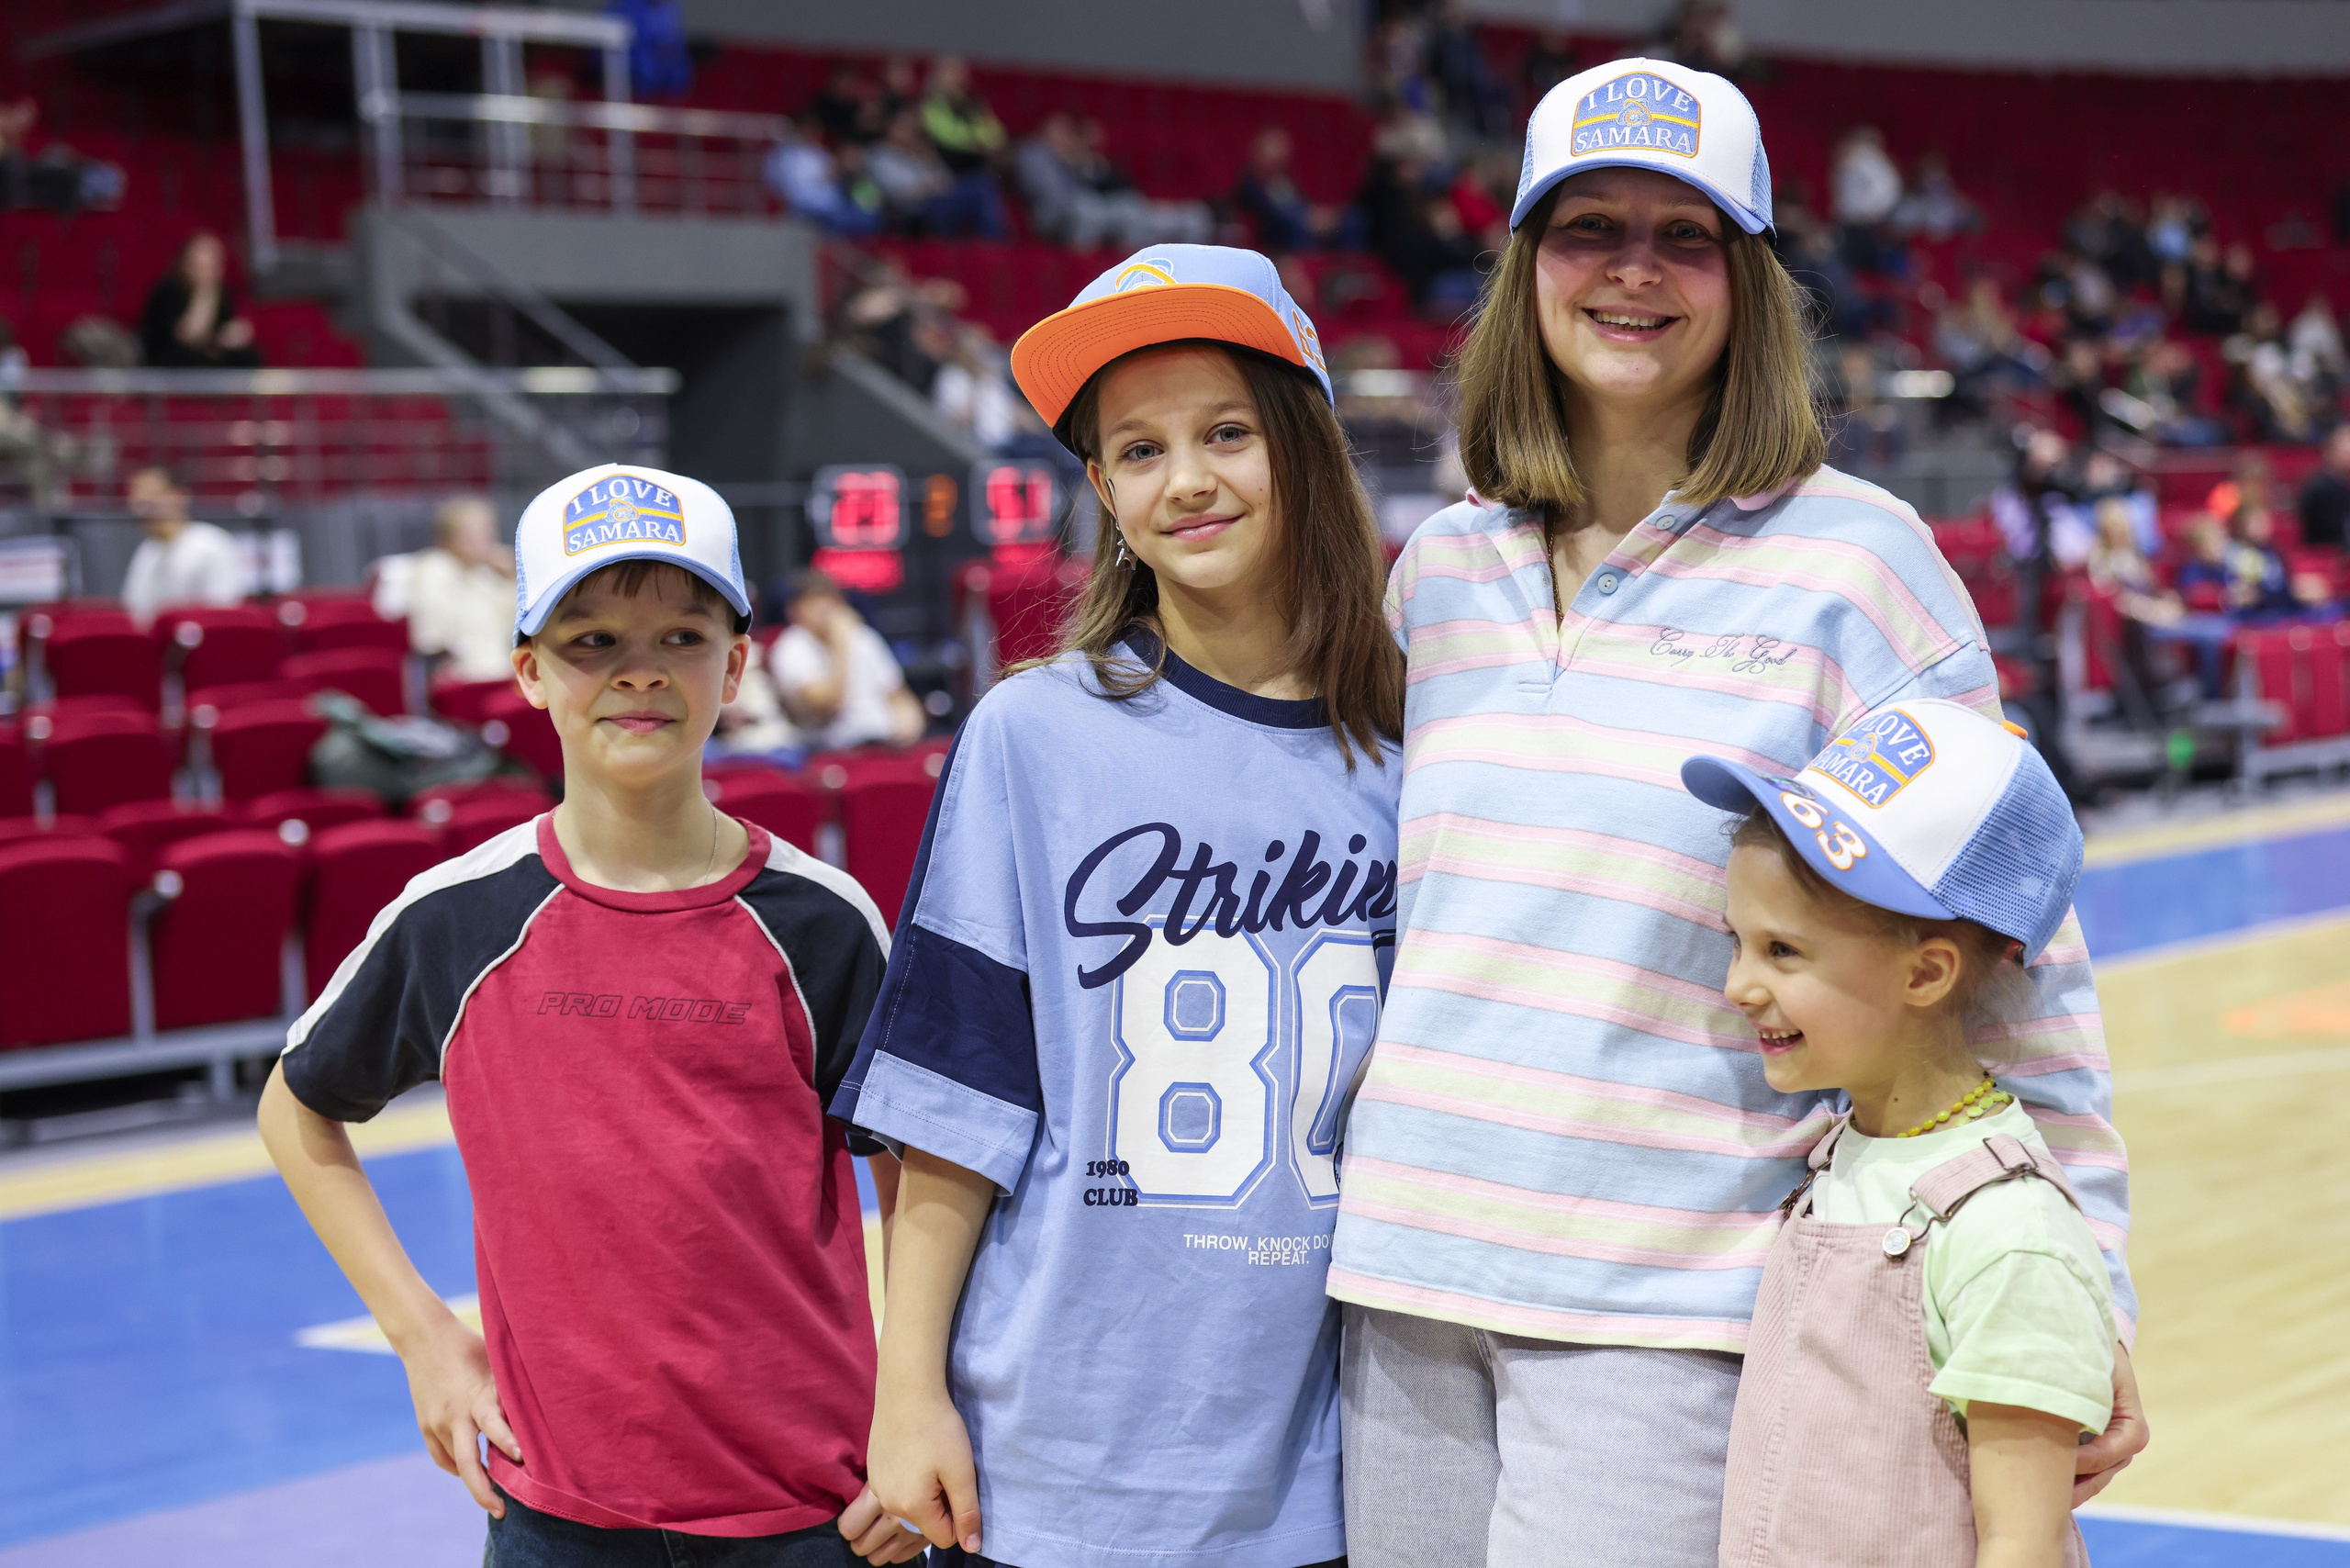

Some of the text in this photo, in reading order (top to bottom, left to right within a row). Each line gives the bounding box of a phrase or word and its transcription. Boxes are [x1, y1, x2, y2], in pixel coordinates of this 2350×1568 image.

[1586, 77, 1694, 112] I LOVE
[1574, 127, 1693, 153] SAMARA
[572, 478, 674, 515] I LOVE
[569, 521, 680, 552] SAMARA
[1861, 714, 1930, 766] LOVE
[1780, 790, 1868, 871] 63
[1065, 822, 1398, 990] Strikin
[537, 991, 752, 1025] PRO MODE
[1105, 913, 1381, 1210] 80
[1086, 1159, 1130, 1179] 1980
[1083, 1188, 1138, 1206] CLUB
[1183, 1234, 1252, 1251] THROW.
[1257, 1236, 1311, 1252] KNOCK
[1248, 1250, 1310, 1266] REPEAT.
